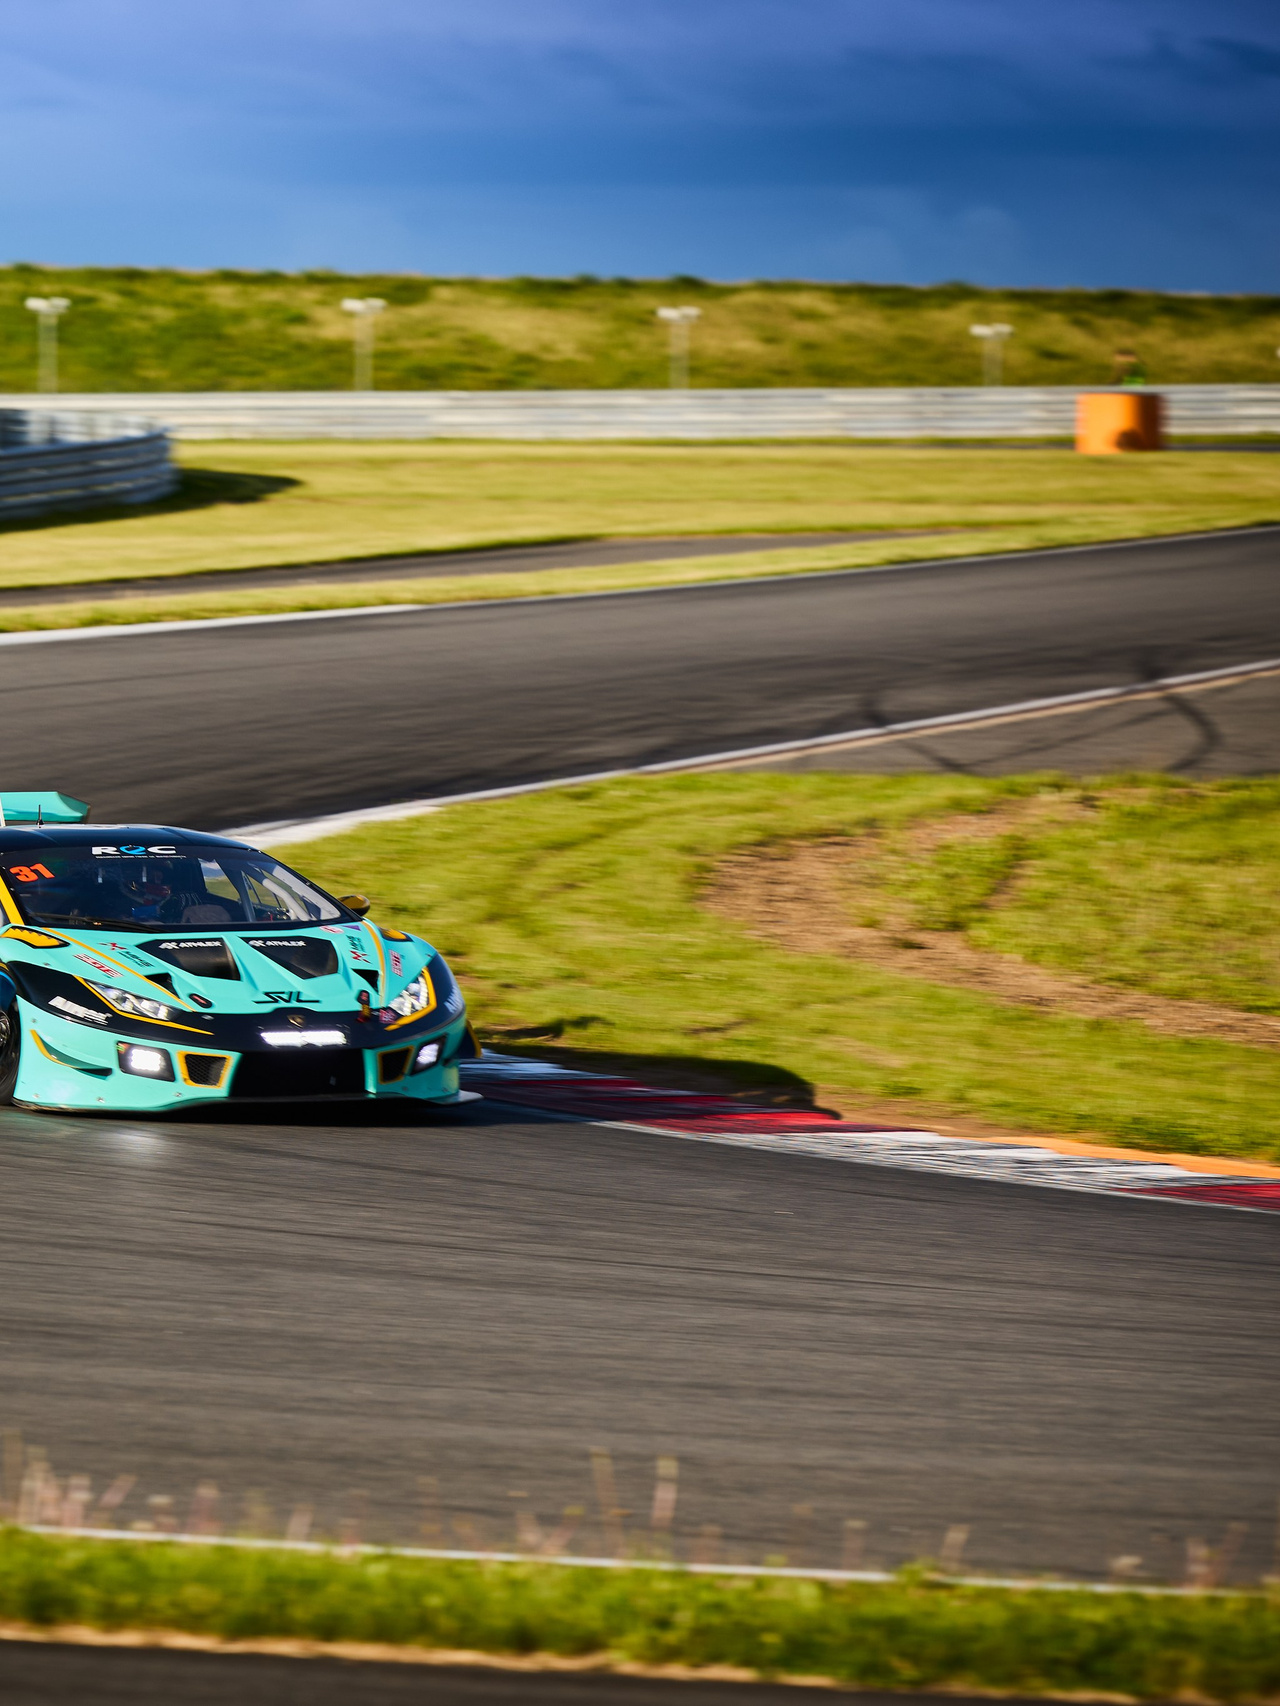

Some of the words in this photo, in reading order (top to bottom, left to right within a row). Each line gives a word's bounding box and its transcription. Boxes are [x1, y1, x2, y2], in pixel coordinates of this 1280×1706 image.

[9, 863, 56, 883] 31
[178, 941, 222, 949] ATHLEX
[253, 991, 321, 1004] SVL
